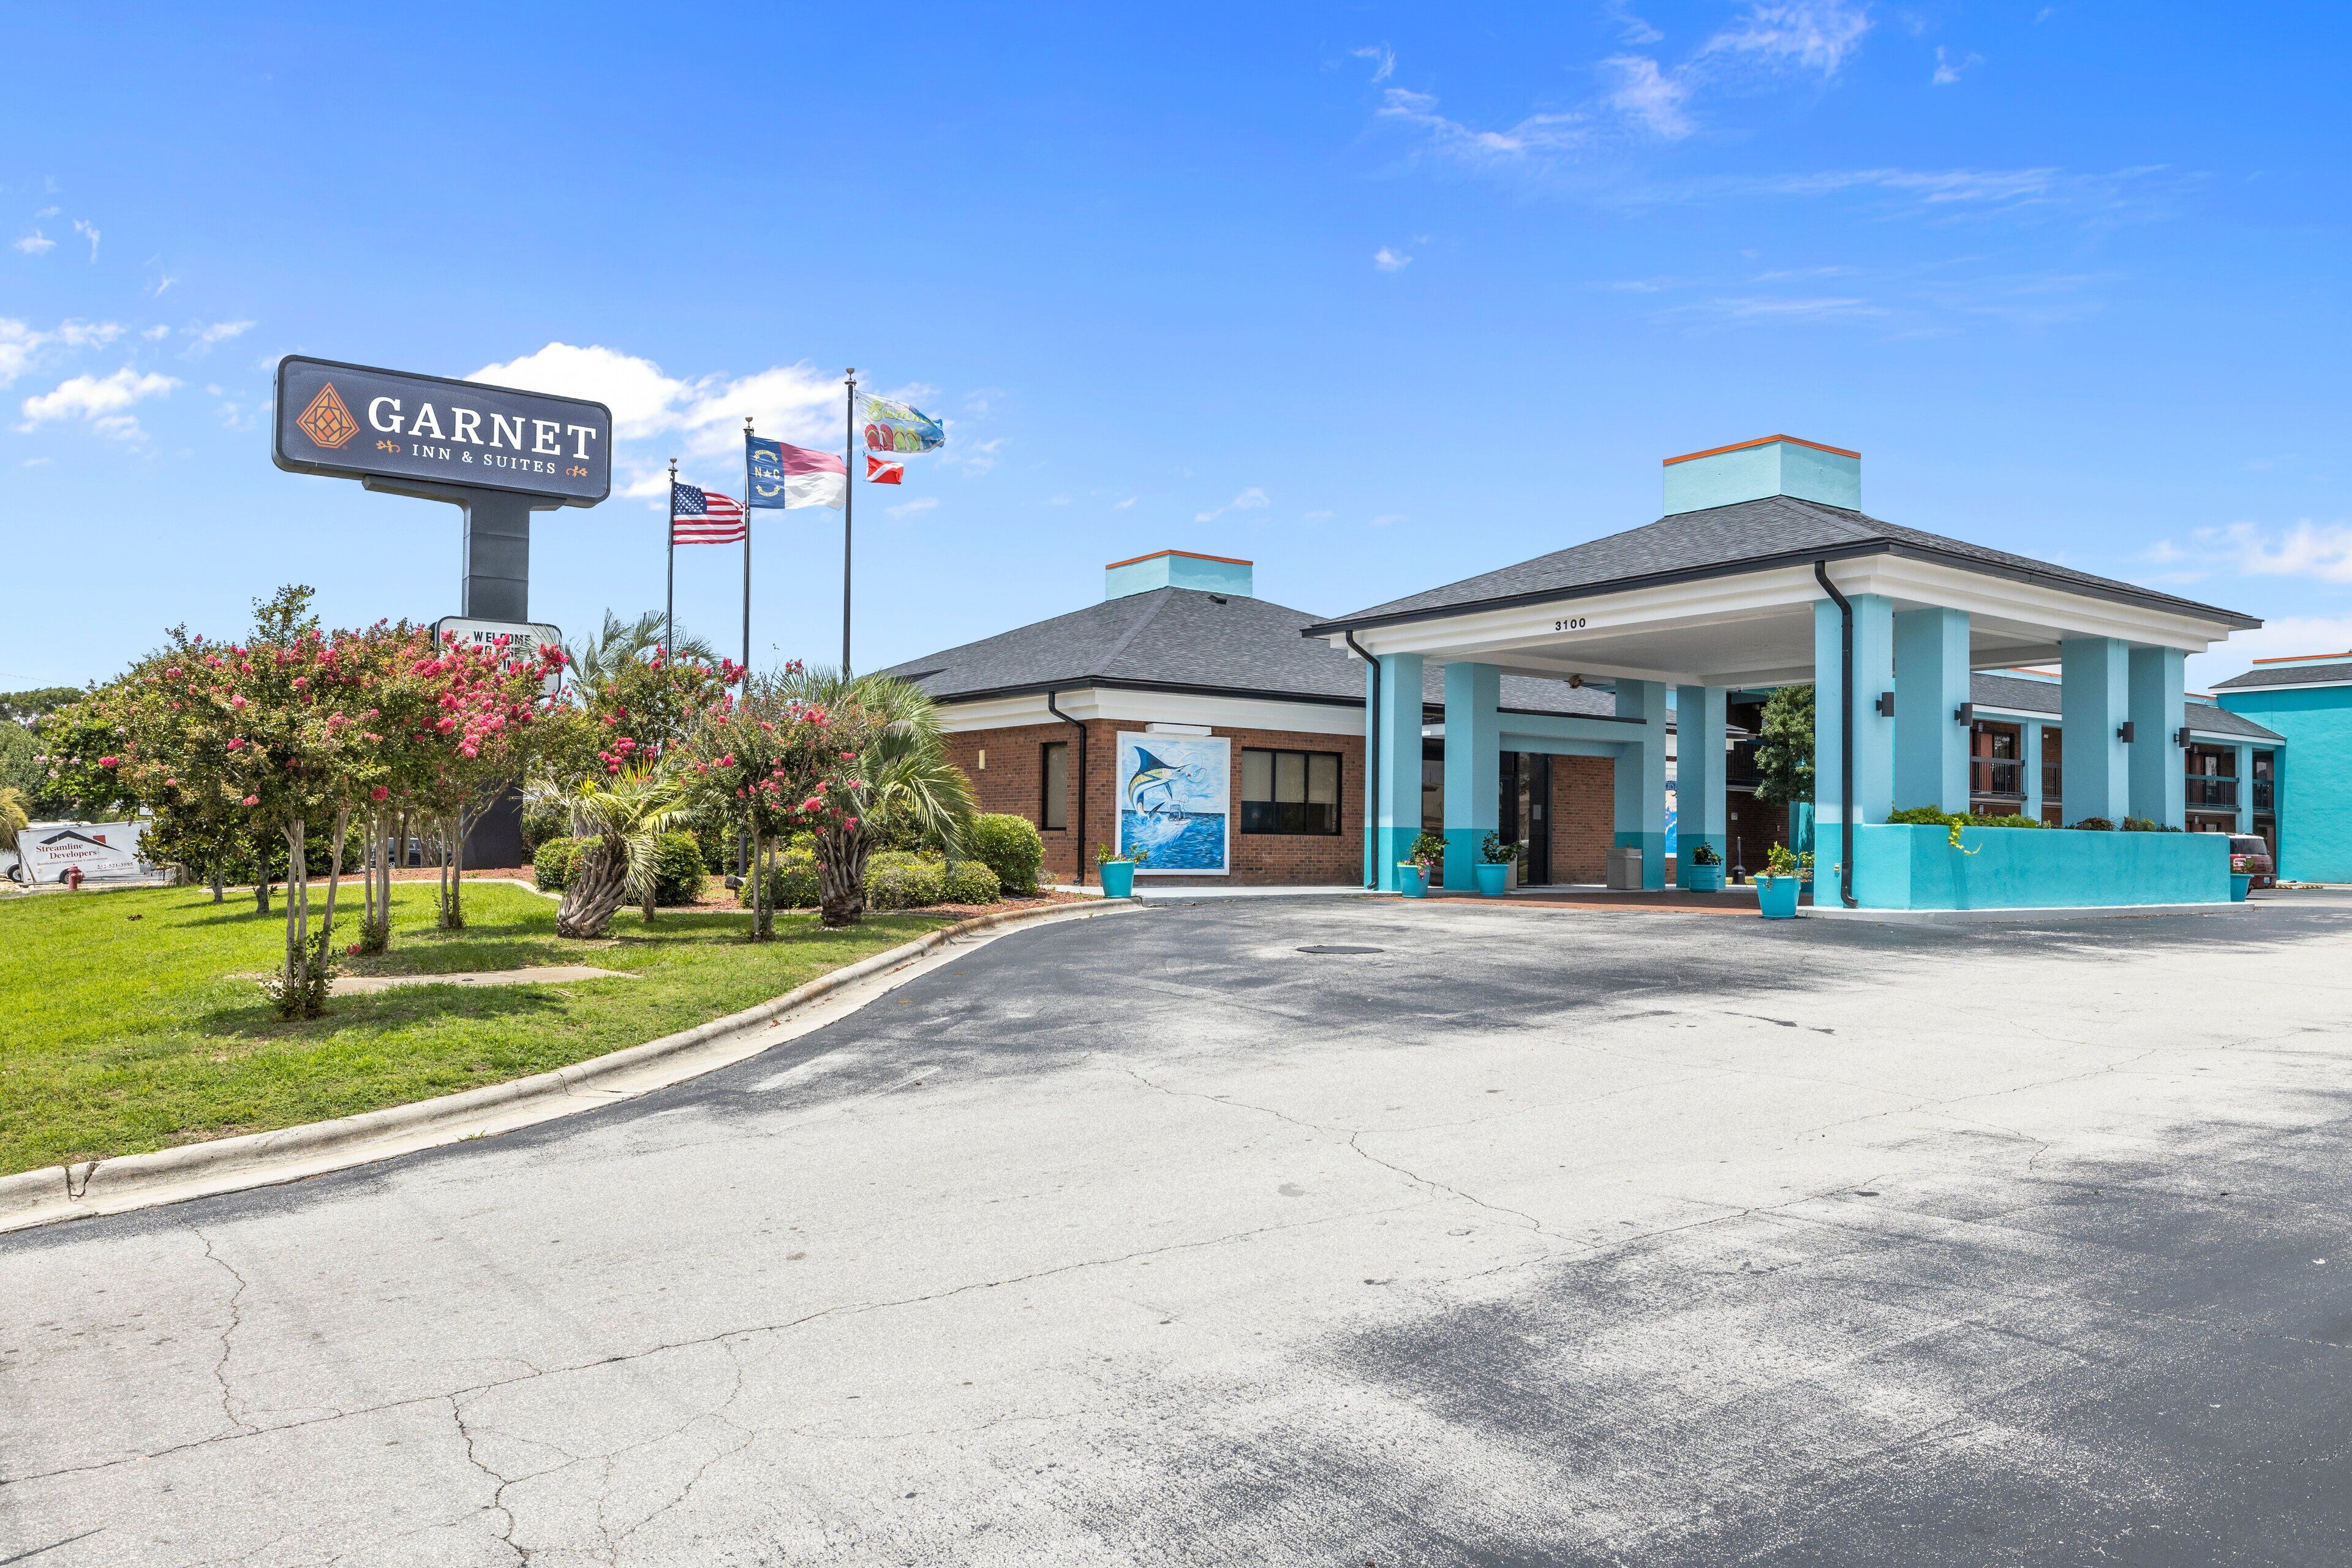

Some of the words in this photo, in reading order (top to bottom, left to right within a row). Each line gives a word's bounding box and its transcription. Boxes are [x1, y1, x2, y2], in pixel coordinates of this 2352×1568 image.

[368, 396, 597, 460] GARNET
[412, 444, 451, 460] INN
[462, 451, 473, 463] &
[483, 454, 556, 473] SUITES
[755, 466, 762, 478] N
[773, 469, 780, 480] C
[1555, 617, 1586, 631] 3100
[36, 843, 83, 853] Streamline
[50, 850, 97, 859] Developers
